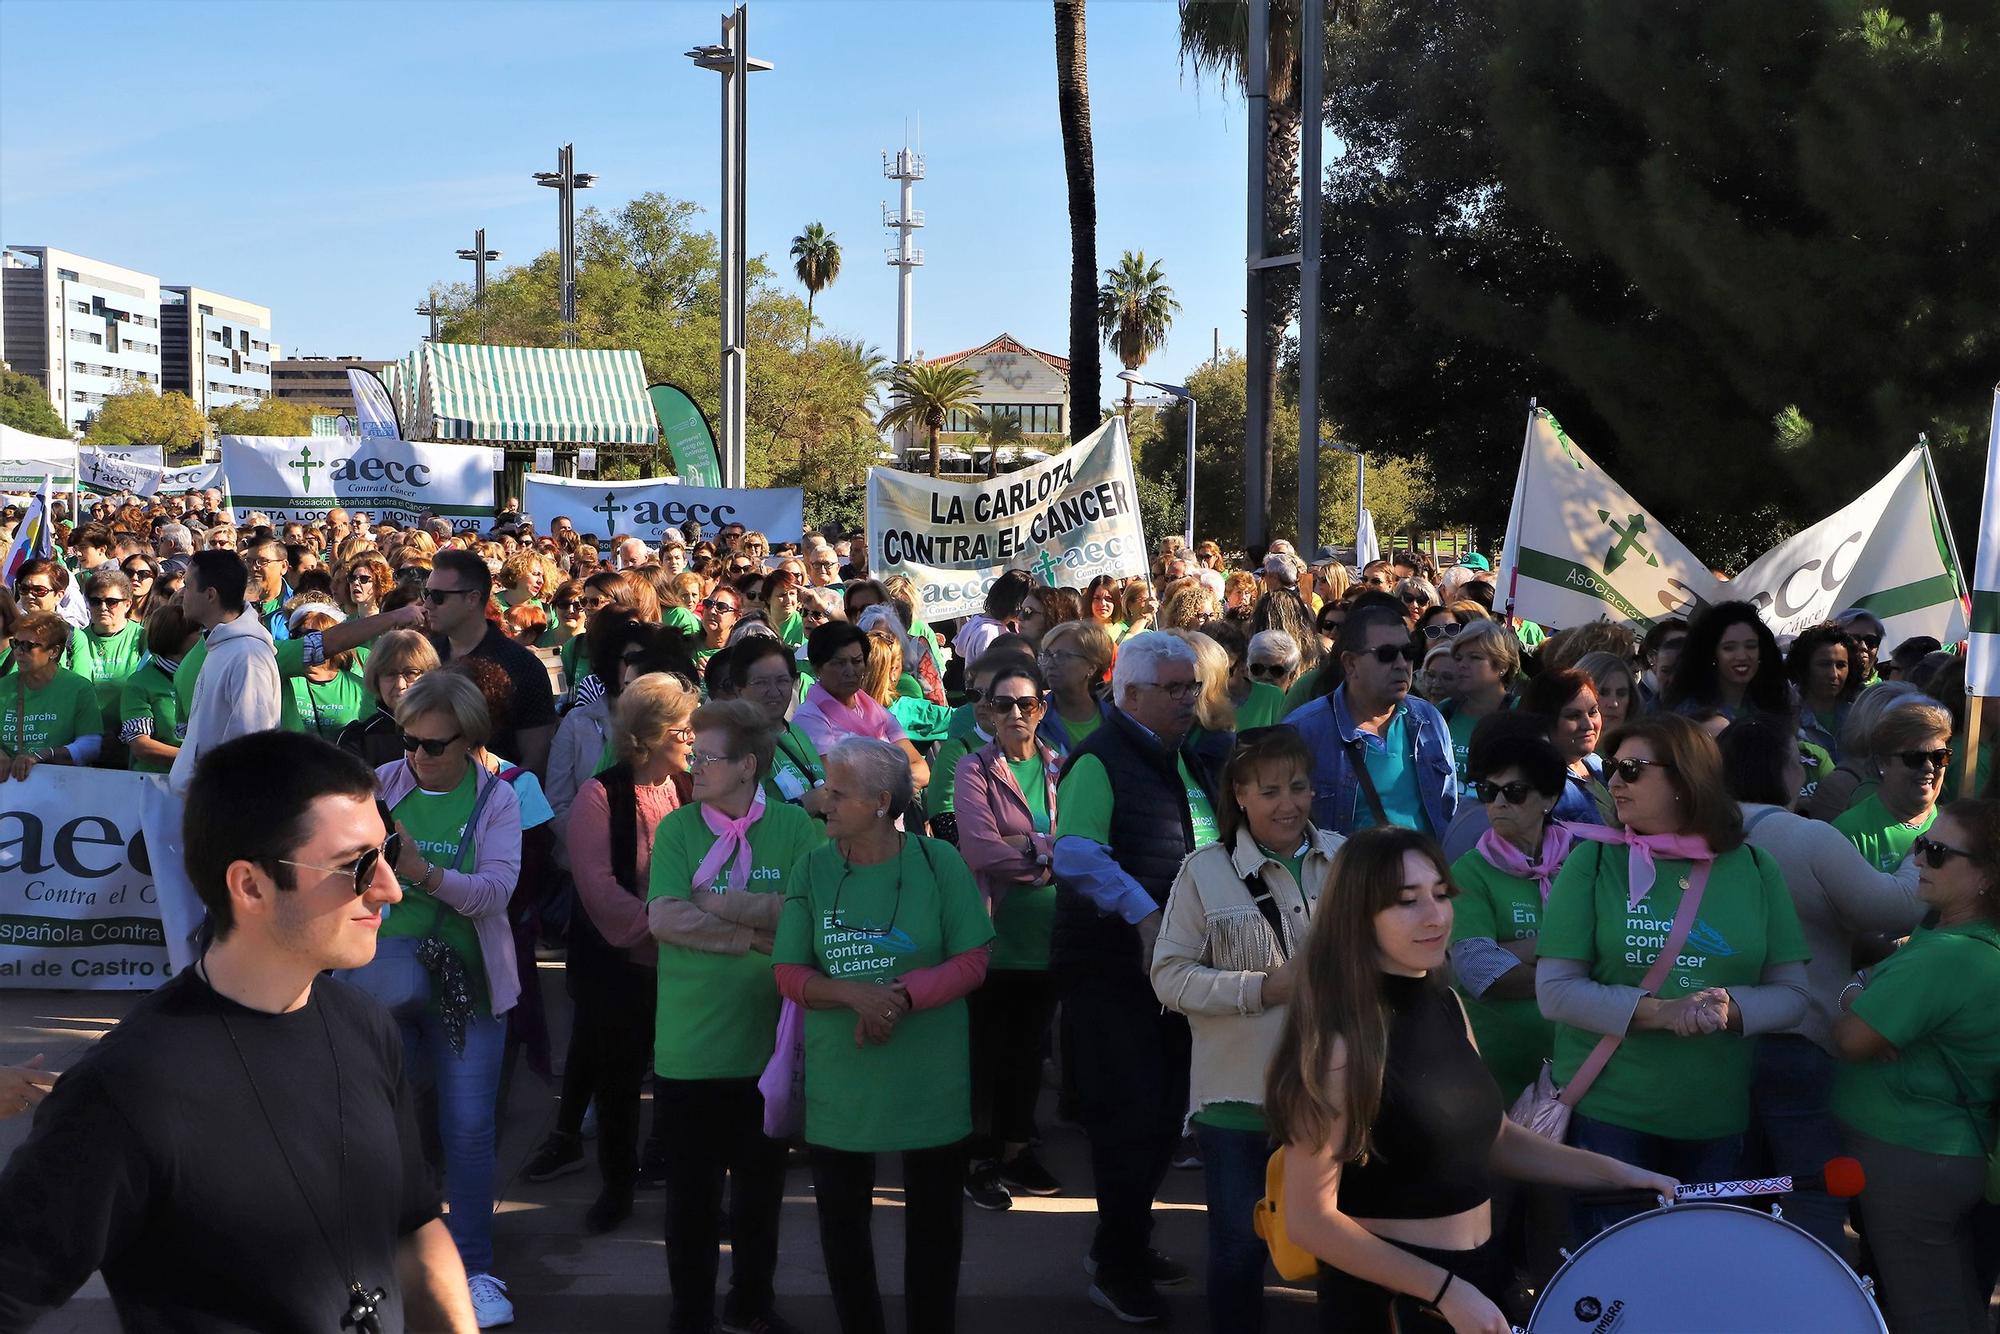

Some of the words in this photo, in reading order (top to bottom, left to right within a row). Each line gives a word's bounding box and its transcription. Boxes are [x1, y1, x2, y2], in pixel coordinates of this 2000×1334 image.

[161, 472, 202, 484] ecc
[330, 455, 431, 487] aecc
[102, 473, 136, 488] aecc
[348, 483, 378, 492] Contra
[380, 484, 388, 492] el
[931, 492, 965, 525] LA
[974, 458, 1073, 523] CARLOTA
[288, 498, 333, 507] Asociación
[335, 498, 371, 508] Española
[373, 498, 397, 506] Contra
[383, 511, 480, 529] MONTYOR
[634, 501, 735, 527] aecc
[884, 528, 989, 564] CONTRA
[998, 525, 1024, 558] EL
[1030, 480, 1129, 544] CÁNCER
[1076, 566, 1102, 580] Contra
[1565, 567, 1647, 626] Asociación
[928, 604, 958, 615] Contra
[5, 713, 18, 723] En
[3, 723, 34, 732] cotra
[2, 733, 11, 741] el
[25, 881, 96, 905] Contra
[109, 884, 127, 905] el
[823, 917, 842, 930] En
[1513, 909, 1537, 923] En
[91, 923, 160, 941] Contra
[825, 943, 874, 960] contra
[1625, 949, 1642, 963] el
[1646, 953, 1707, 968] ccer
[31, 960, 62, 977] de
[71, 958, 154, 977] Castro
[829, 960, 840, 975] el
[842, 956, 896, 972] cáncer
